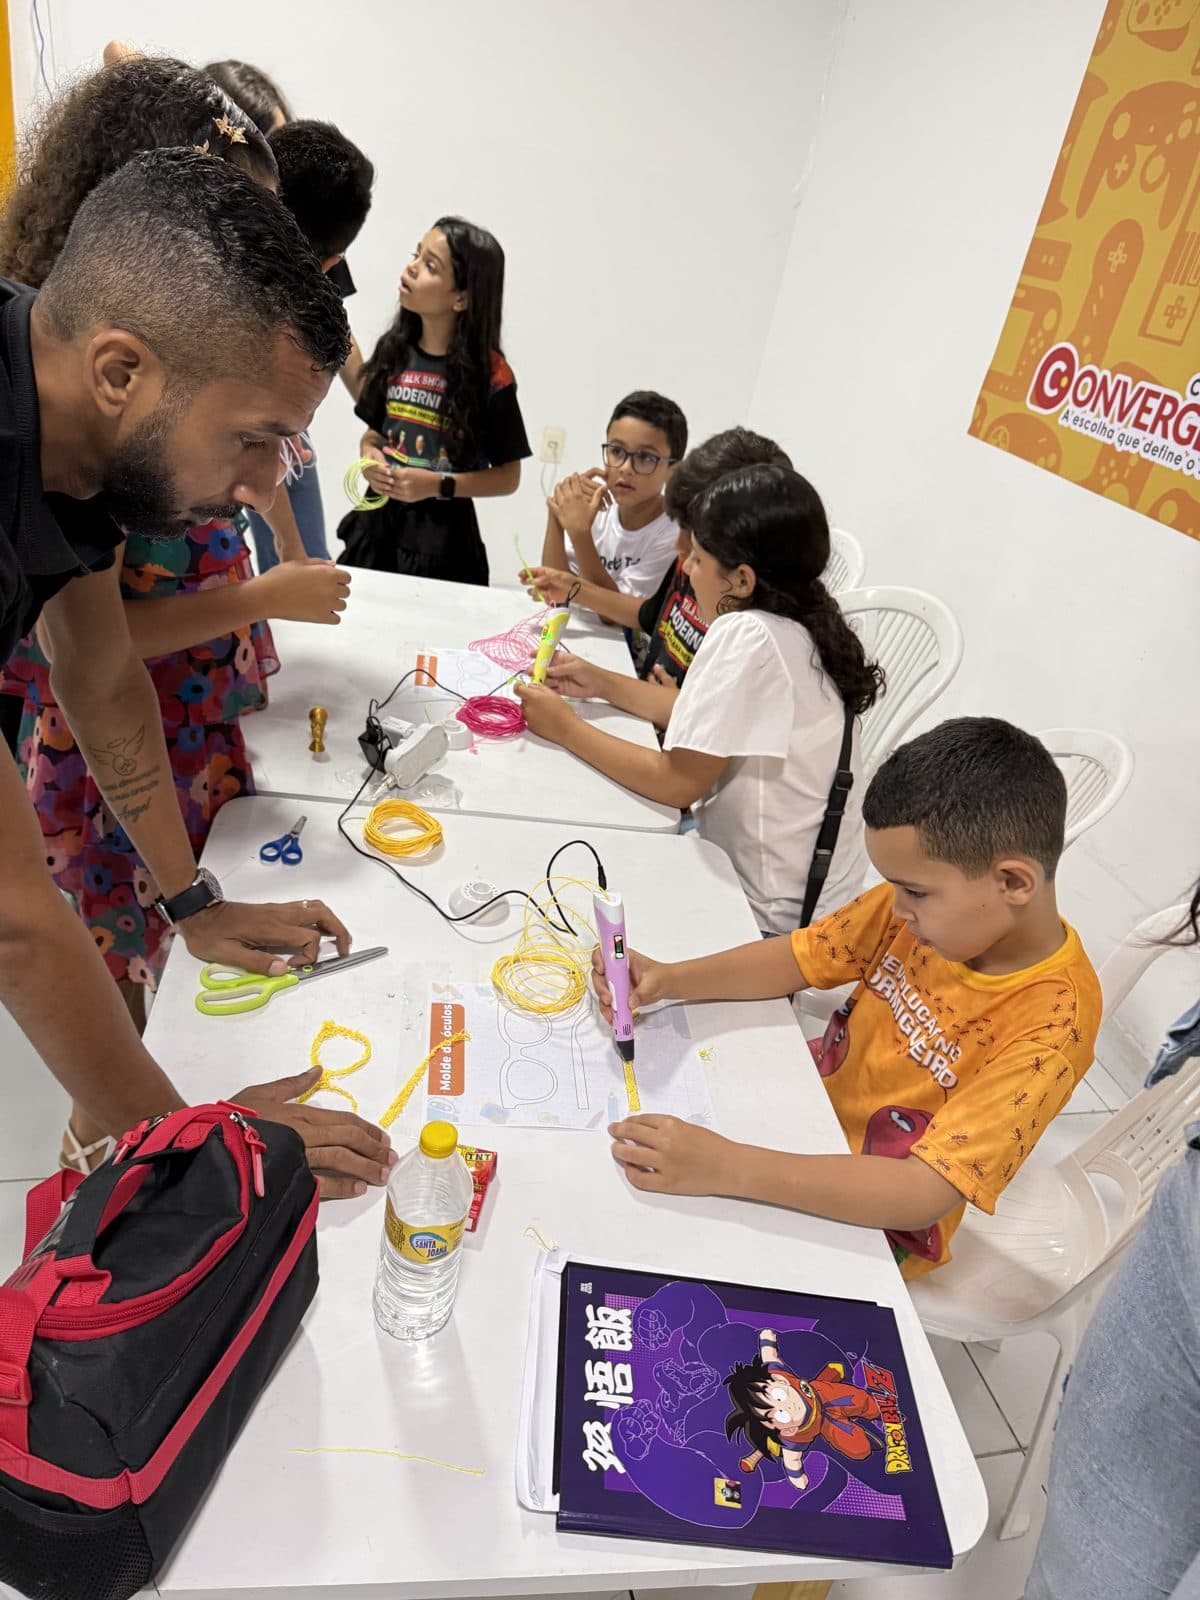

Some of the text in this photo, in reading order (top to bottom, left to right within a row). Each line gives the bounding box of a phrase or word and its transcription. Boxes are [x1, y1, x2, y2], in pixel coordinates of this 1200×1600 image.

[387, 385, 442, 409] MODERNI
[1029, 346, 1200, 452] CONVERG
[1062, 409, 1195, 470] A escolha que define o
[440, 1004, 453, 1038] óculos
[440, 1056, 452, 1091] Molde
[415, 1240, 437, 1249] SANTA
[863, 1361, 912, 1474] DRAGON BALL Z
